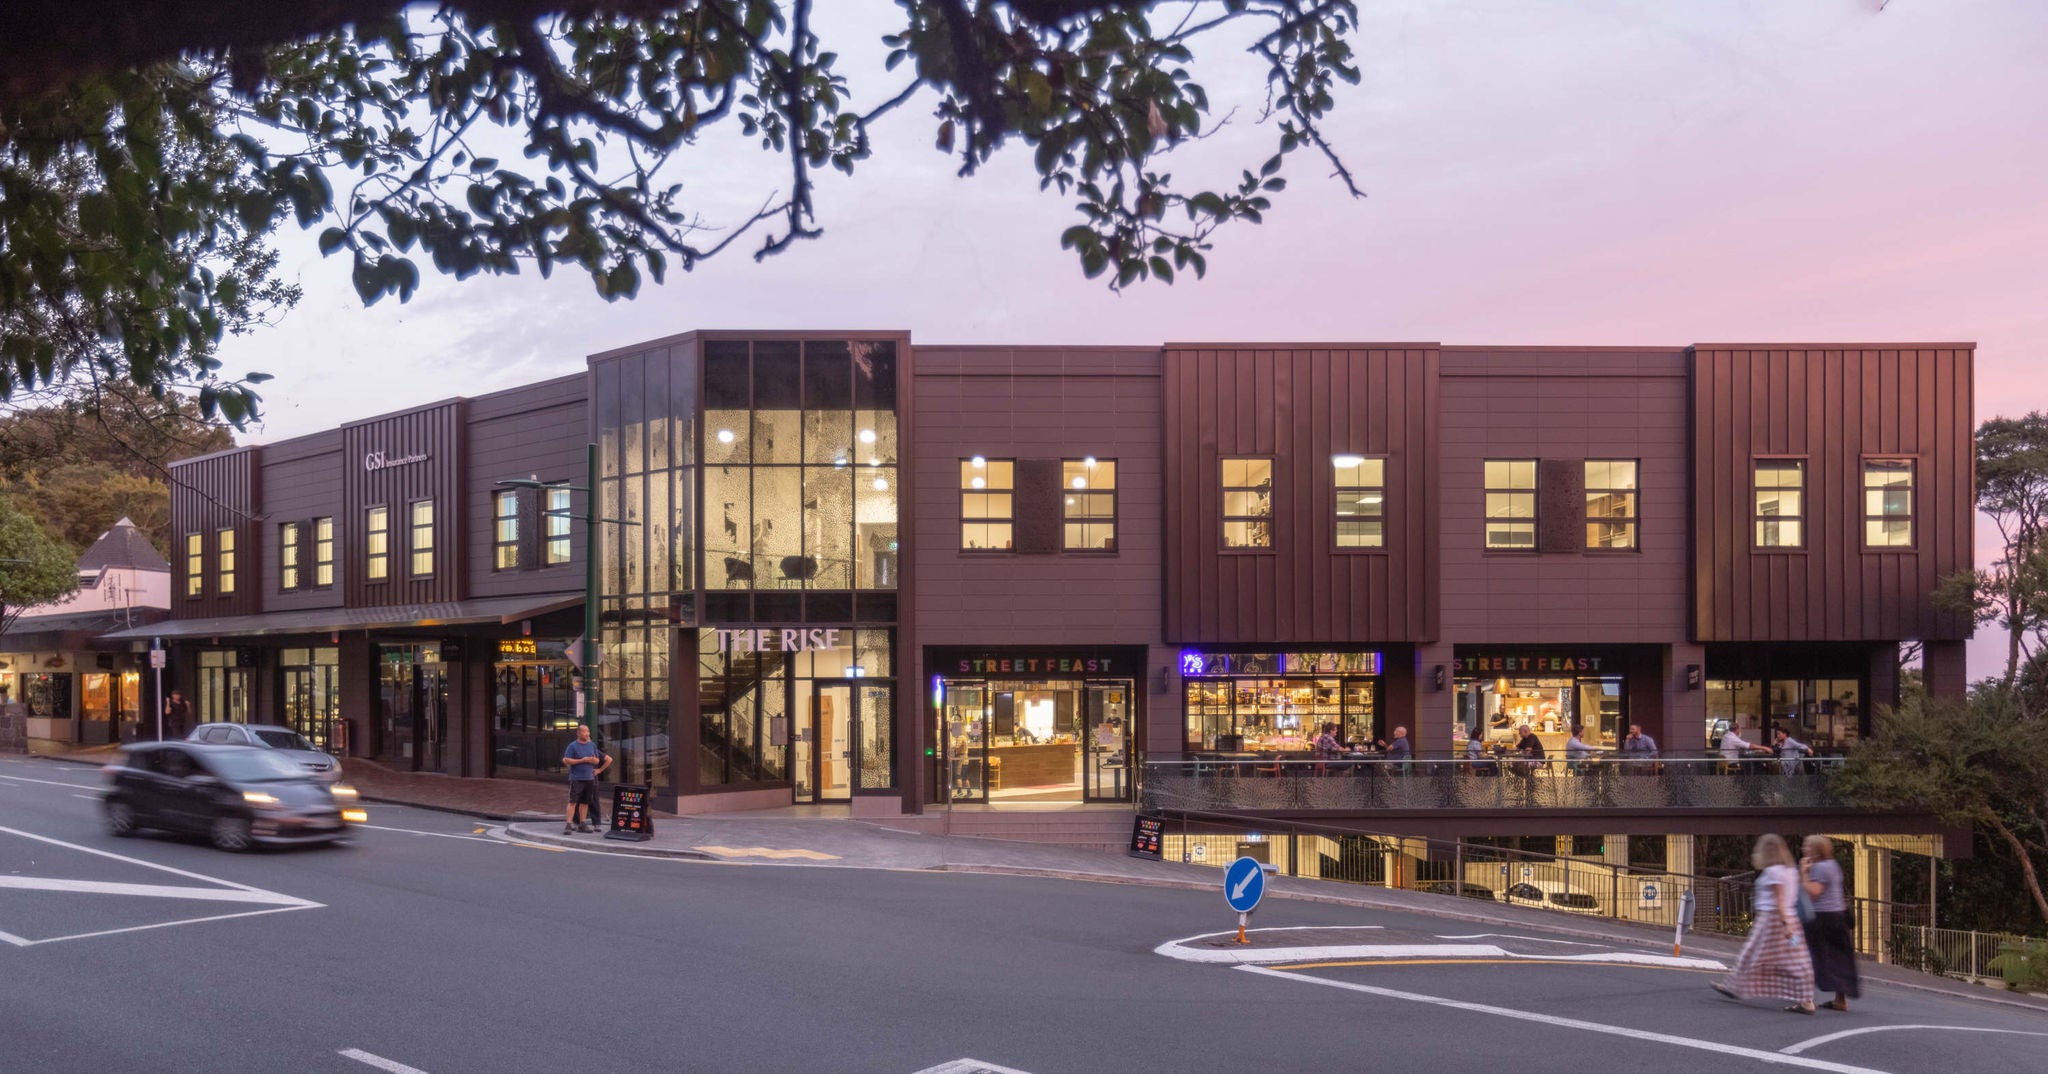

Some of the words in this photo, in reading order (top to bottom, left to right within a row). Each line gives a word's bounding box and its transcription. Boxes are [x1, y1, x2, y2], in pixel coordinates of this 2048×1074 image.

[365, 451, 385, 471] GSI
[408, 453, 428, 463] Partners
[717, 628, 770, 652] THE
[781, 628, 840, 652] RISE
[959, 659, 1039, 673] STREET
[1046, 659, 1112, 673] FEAST
[1453, 657, 1531, 671] STREET
[1538, 657, 1602, 671] FEAST
